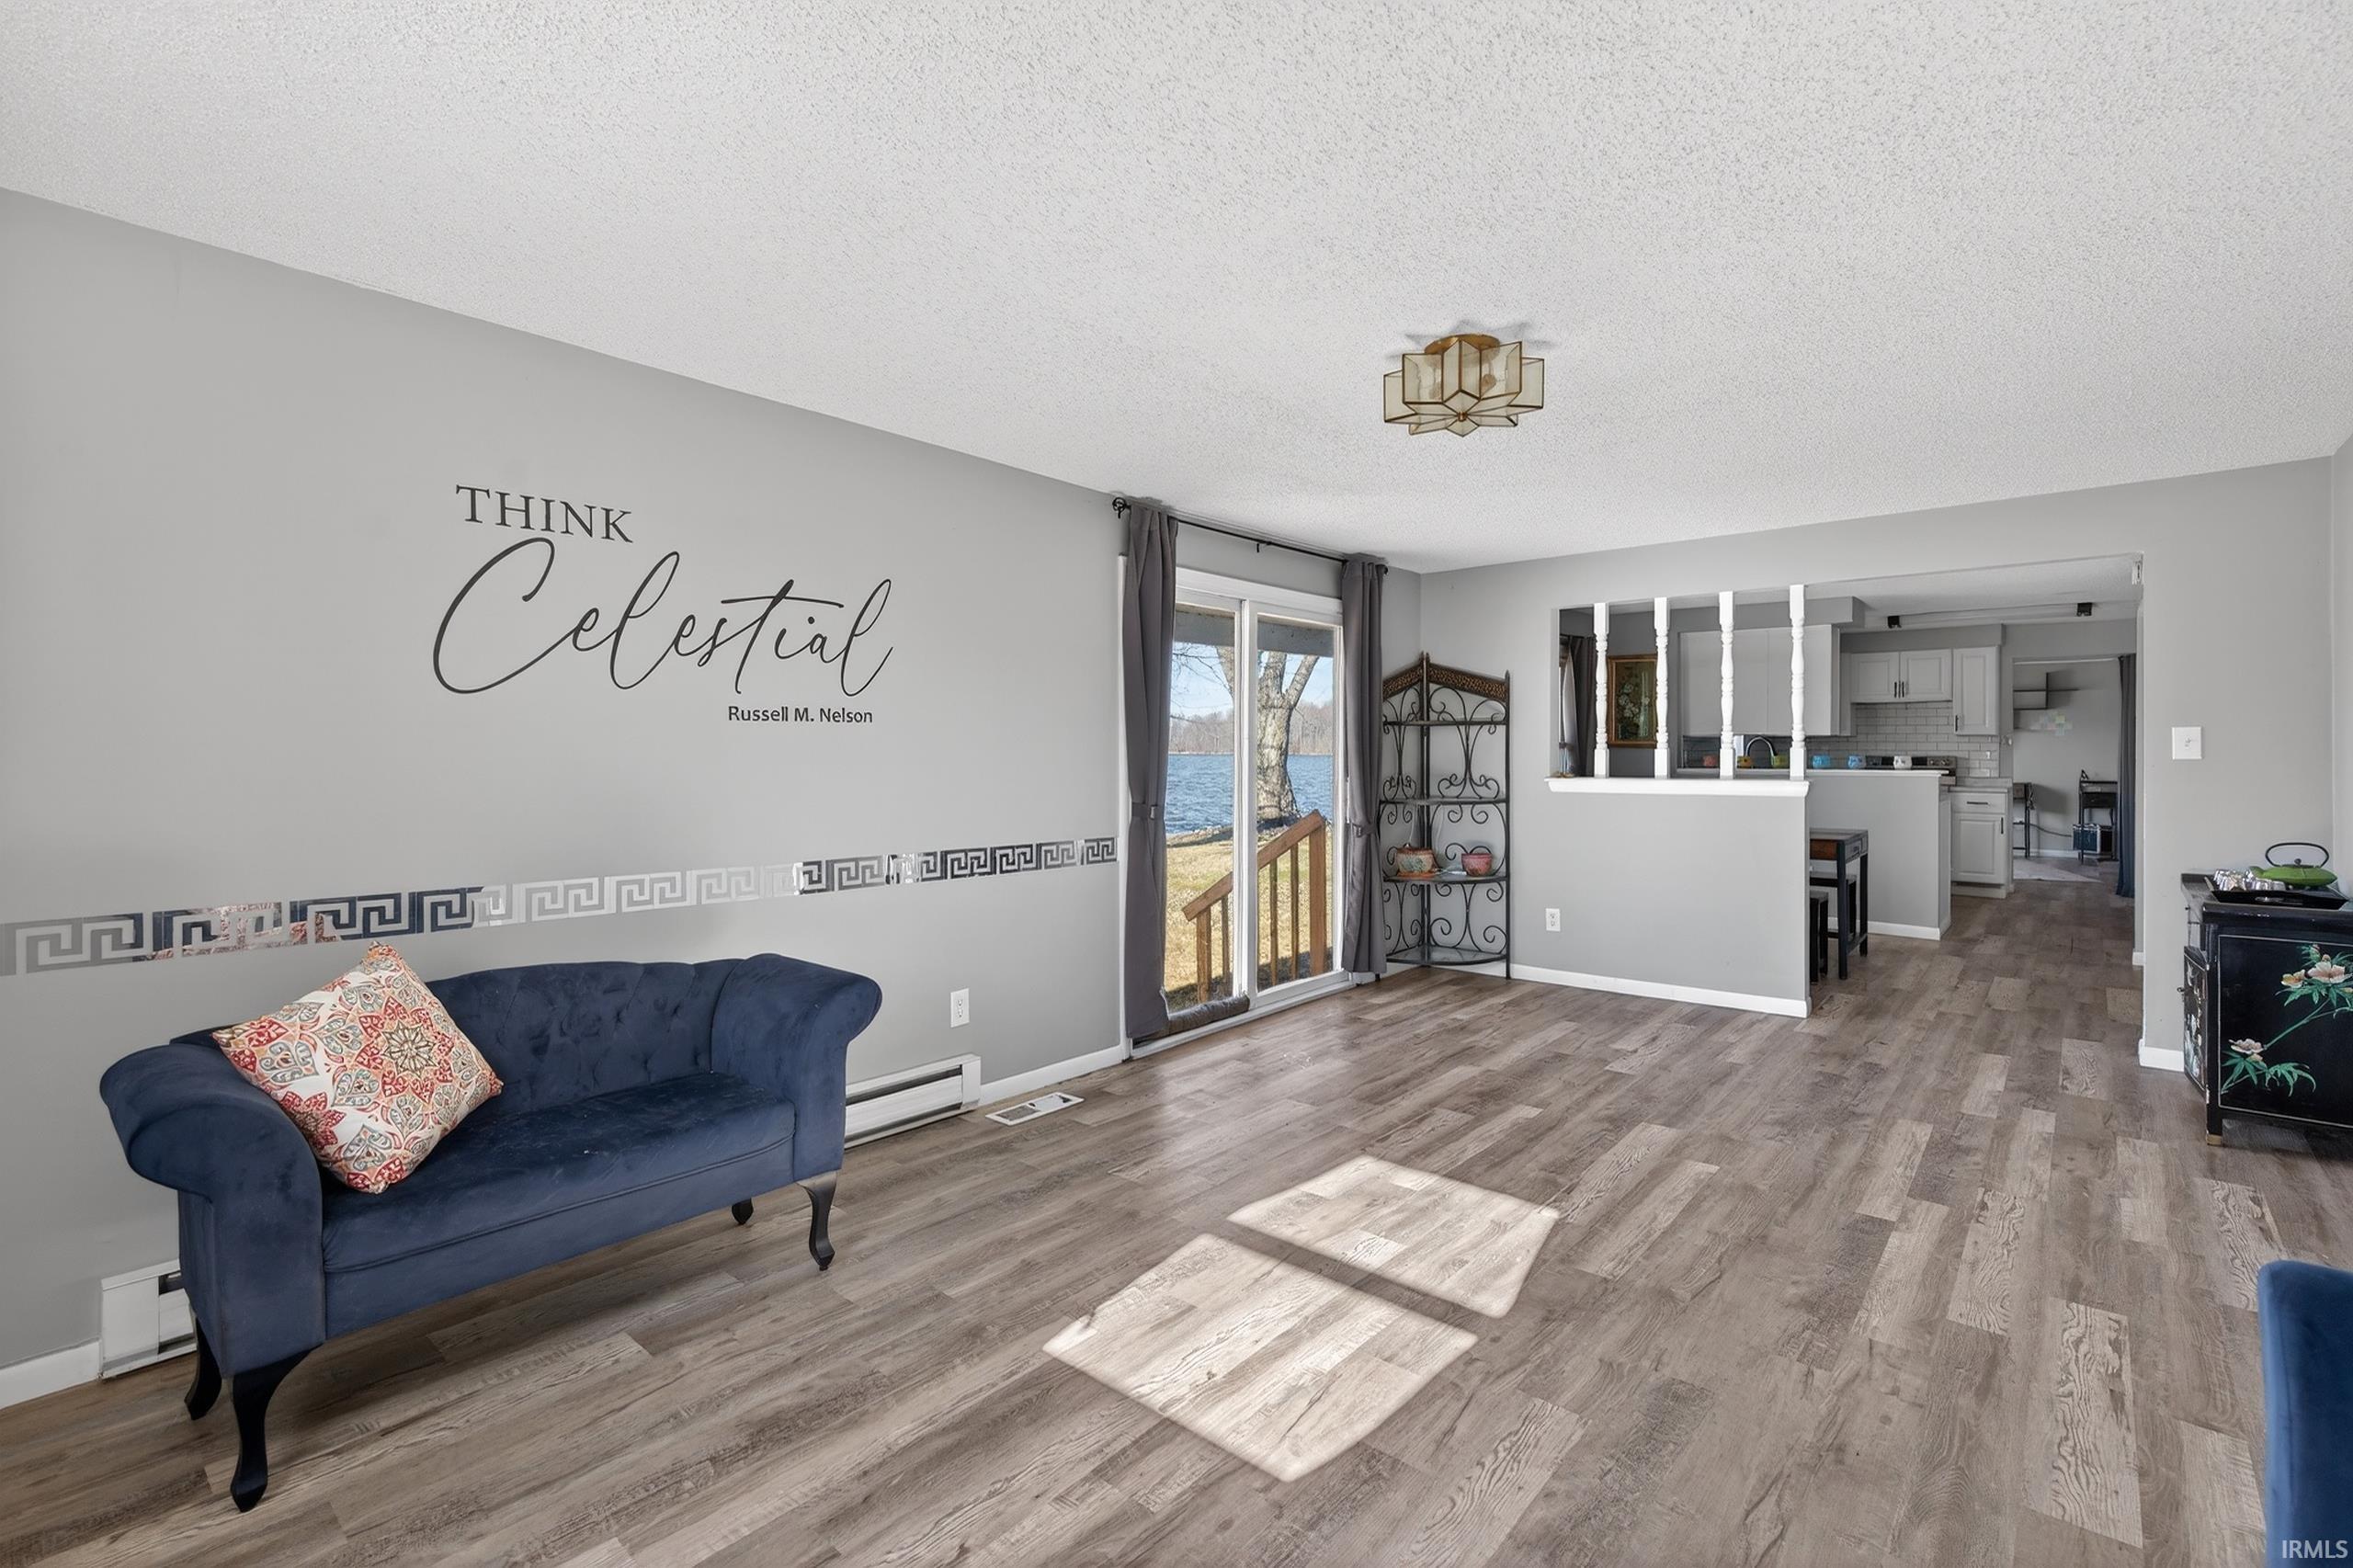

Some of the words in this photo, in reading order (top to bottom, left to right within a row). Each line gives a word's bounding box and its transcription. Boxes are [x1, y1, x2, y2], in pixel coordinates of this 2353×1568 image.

[456, 484, 633, 543] THINK
[433, 537, 893, 697] Celestial
[728, 705, 789, 722] Russell
[794, 707, 814, 722] M.
[819, 707, 873, 723] Nelson
